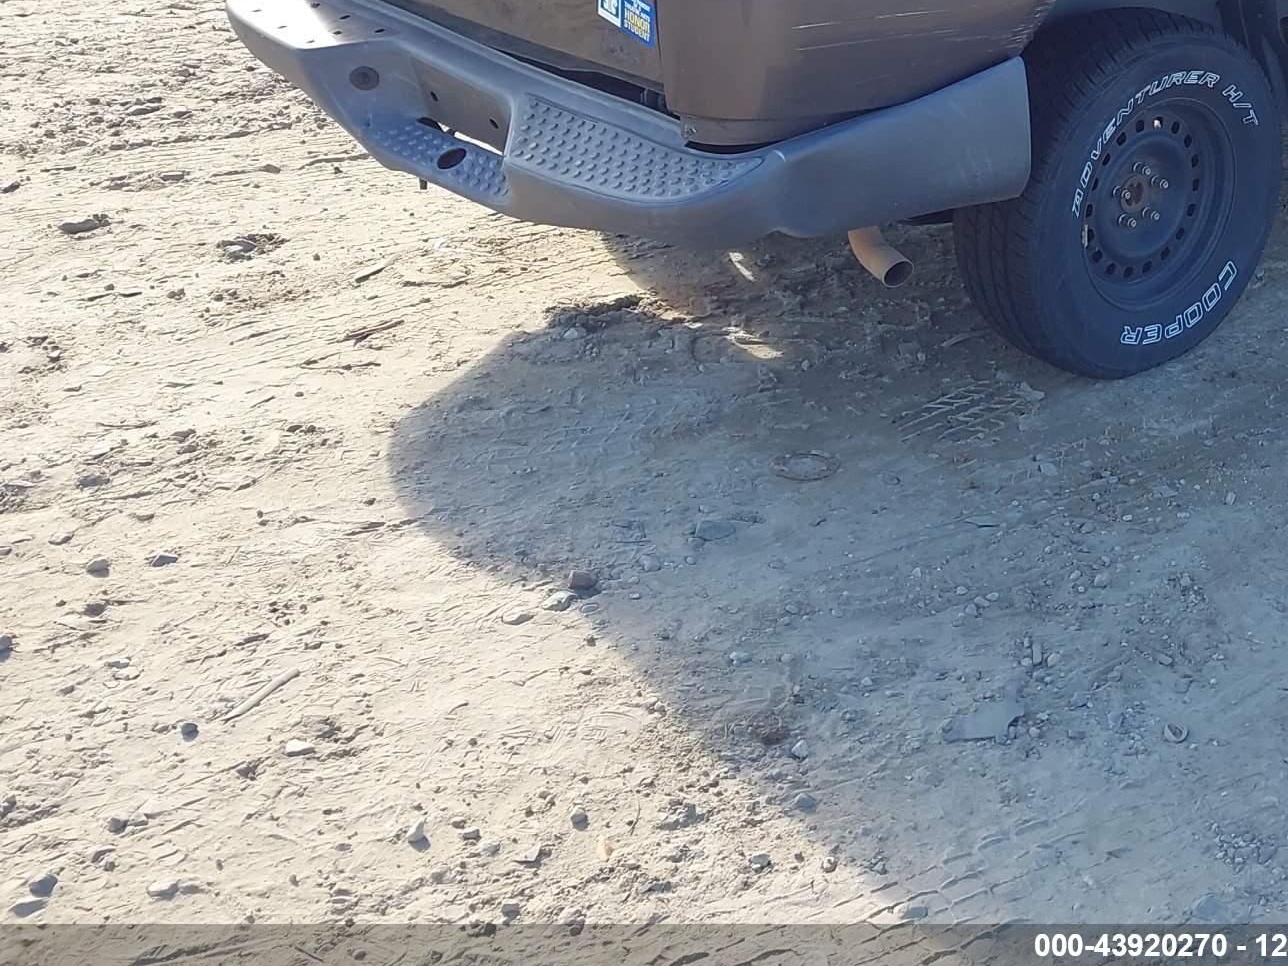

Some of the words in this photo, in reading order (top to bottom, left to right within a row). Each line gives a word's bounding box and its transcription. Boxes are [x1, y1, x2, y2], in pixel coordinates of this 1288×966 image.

[624, 8, 650, 33] HONOR
[624, 19, 650, 43] STUDENT
[1072, 70, 1221, 219] ADVENTURER
[1221, 84, 1259, 126] H/T
[1120, 260, 1238, 346] COOPER
